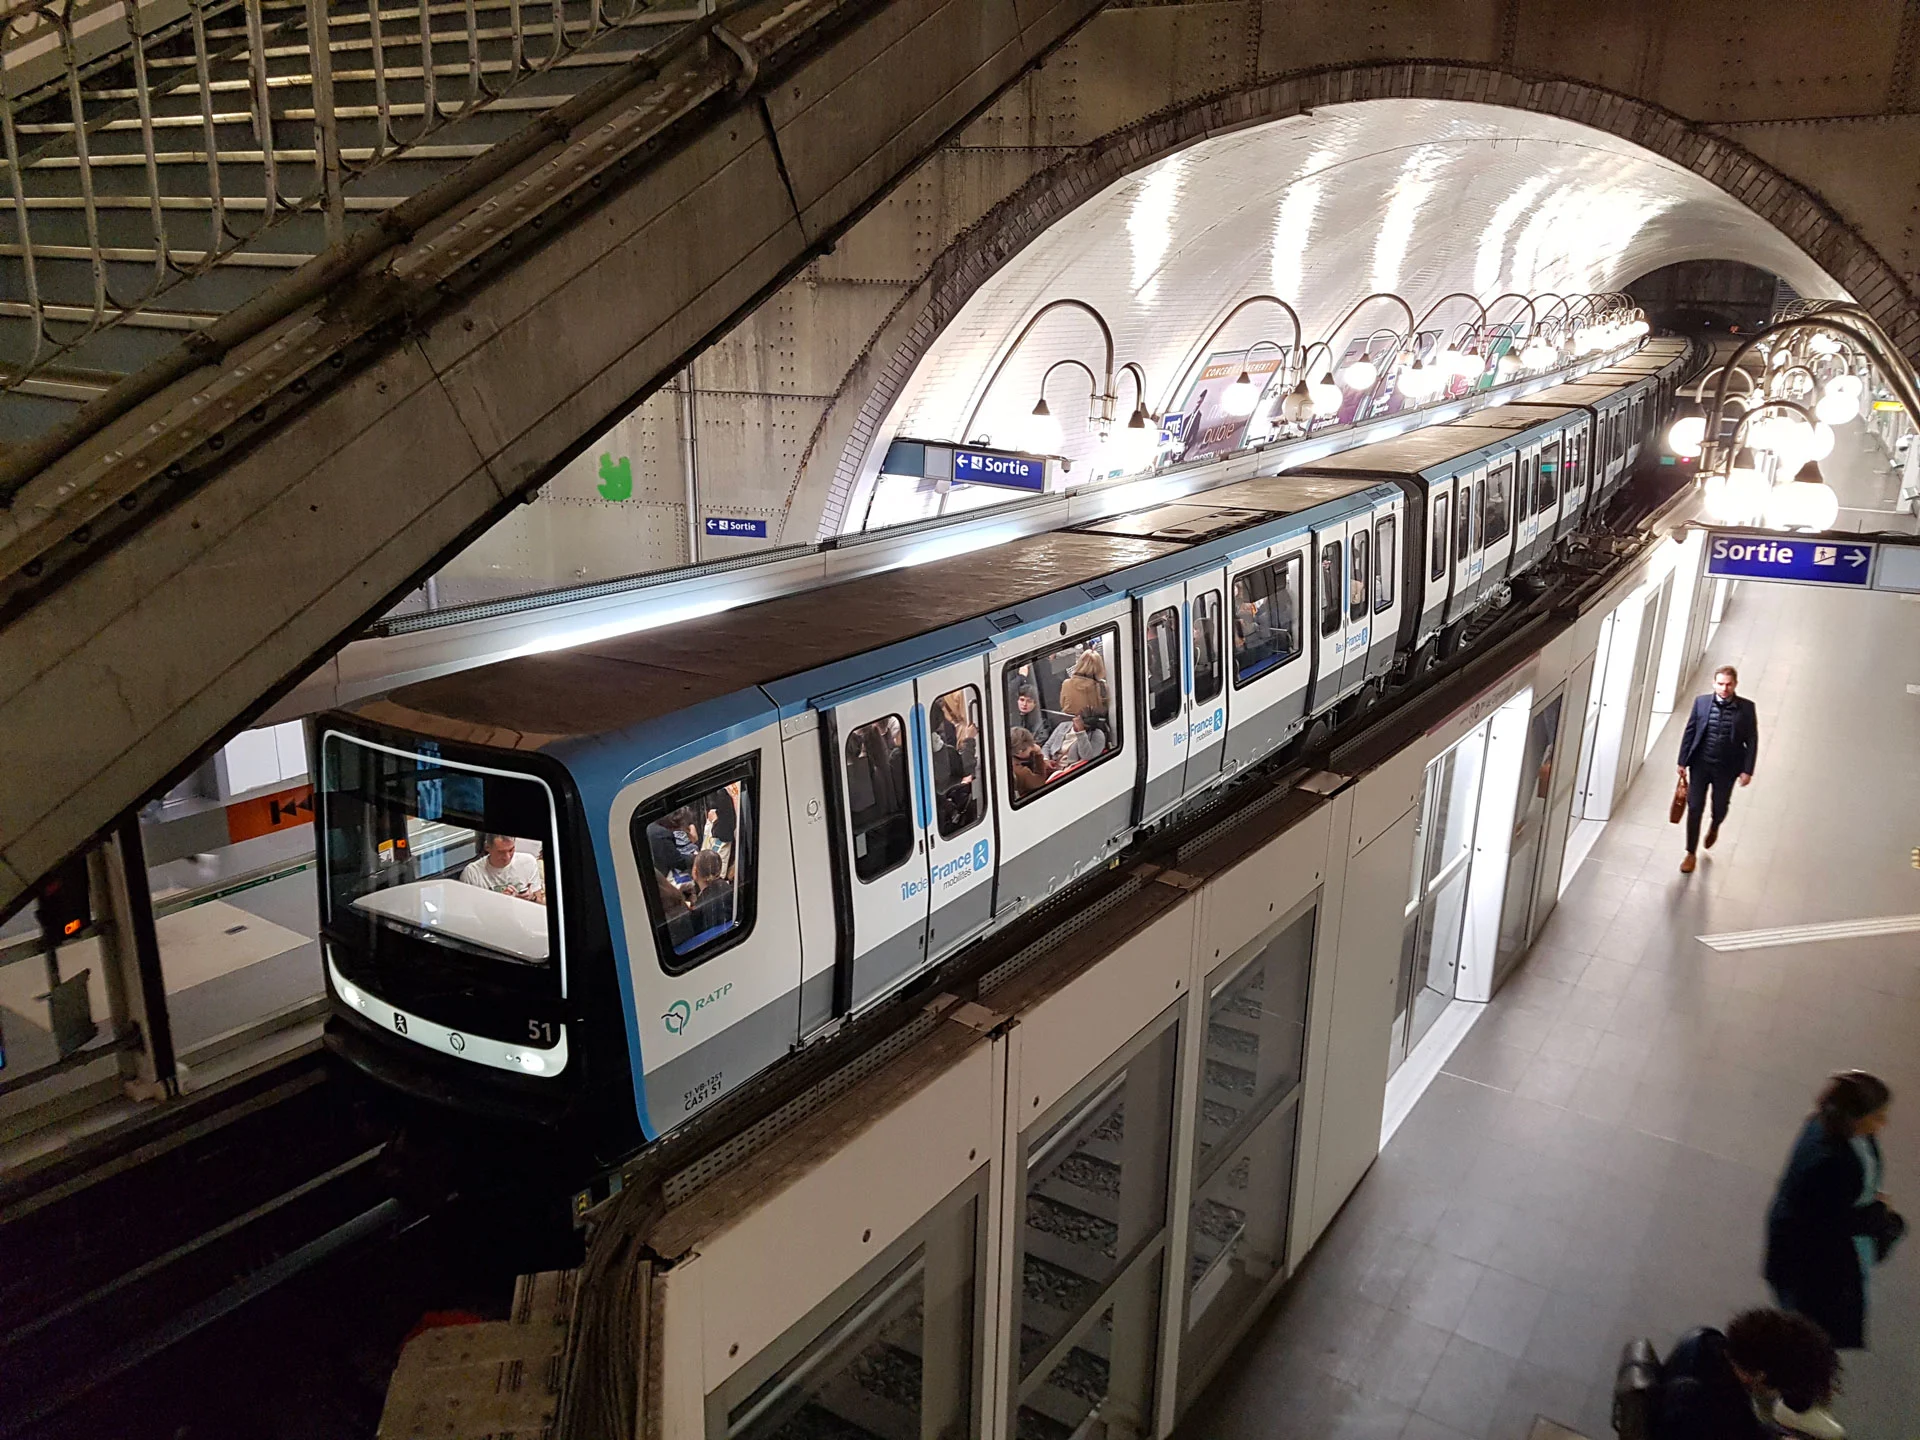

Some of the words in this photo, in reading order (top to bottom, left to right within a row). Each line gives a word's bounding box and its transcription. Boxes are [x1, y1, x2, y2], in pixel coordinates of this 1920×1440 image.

[985, 457, 1029, 476] Sortie
[730, 521, 756, 531] Sortie
[1713, 539, 1793, 564] Sortie
[1190, 715, 1212, 737] France
[931, 852, 972, 884] France
[695, 982, 733, 1011] RATP
[529, 1019, 551, 1042] 51
